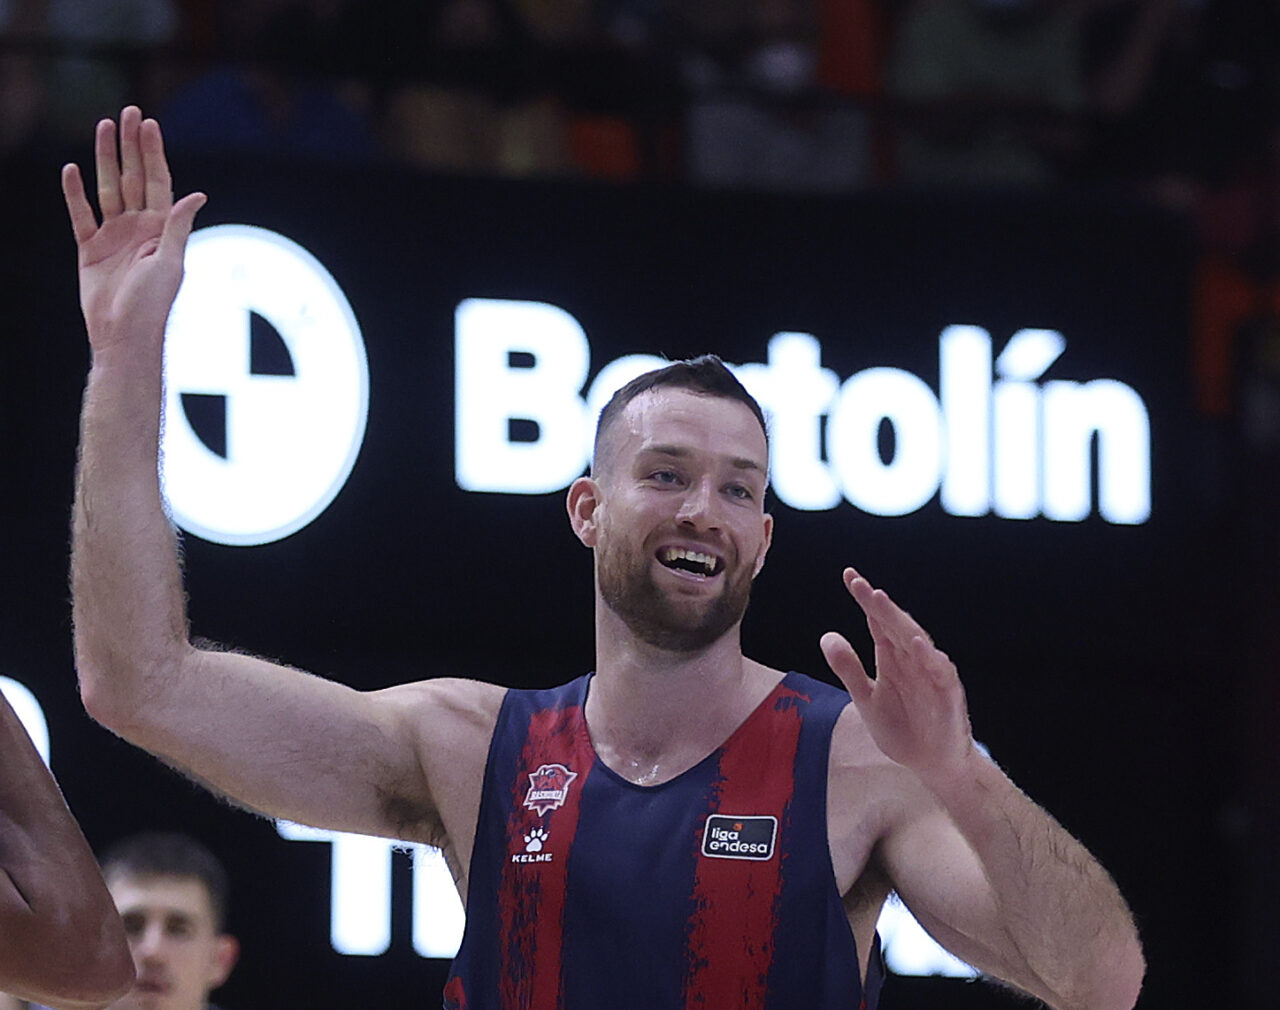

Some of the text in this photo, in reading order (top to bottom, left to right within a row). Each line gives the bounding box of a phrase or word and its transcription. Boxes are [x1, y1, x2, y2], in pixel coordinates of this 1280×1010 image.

[455, 299, 1151, 525] Btolín
[711, 828, 739, 841] liga
[709, 841, 768, 853] endesa
[511, 853, 553, 863] KELME
